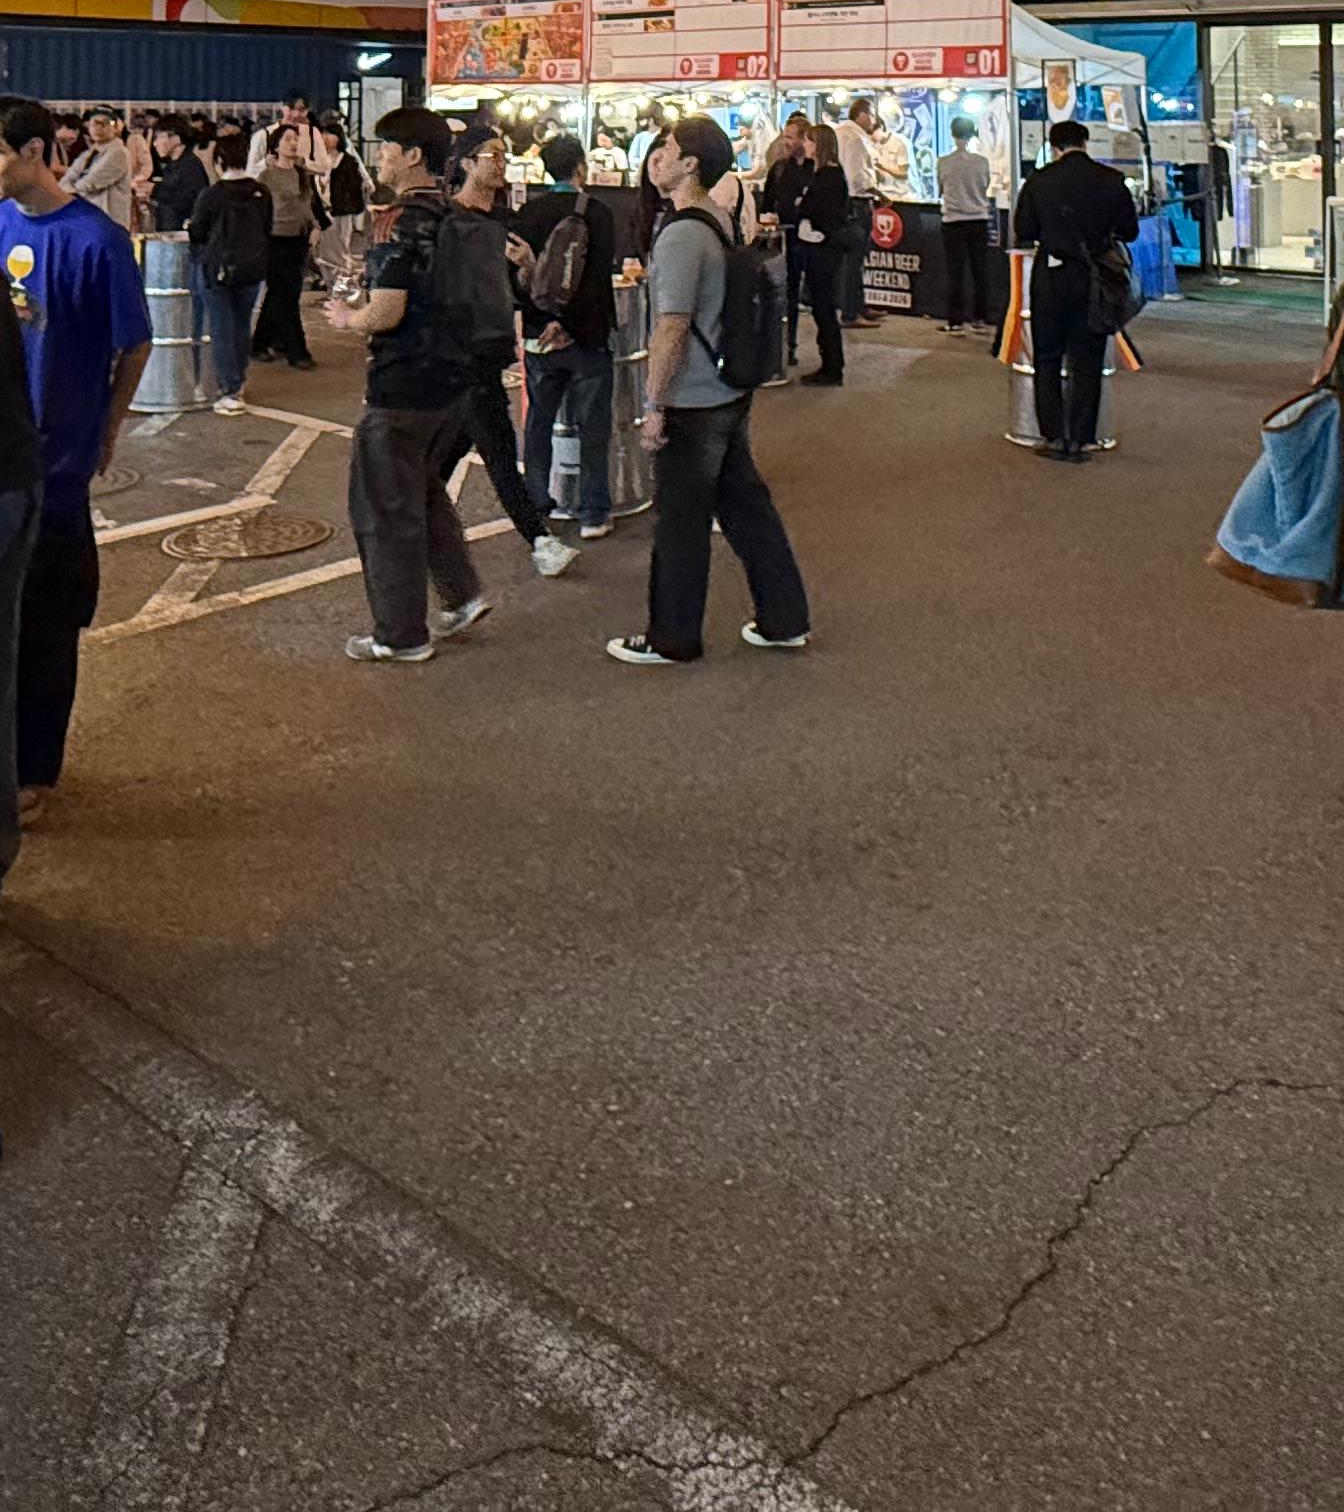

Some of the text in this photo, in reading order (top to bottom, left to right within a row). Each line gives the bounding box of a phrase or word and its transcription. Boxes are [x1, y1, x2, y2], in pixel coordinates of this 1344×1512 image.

[746, 54, 768, 79] 02
[977, 48, 1001, 76] 01
[894, 253, 921, 272] BEER
[862, 269, 911, 291] WEEKEND
